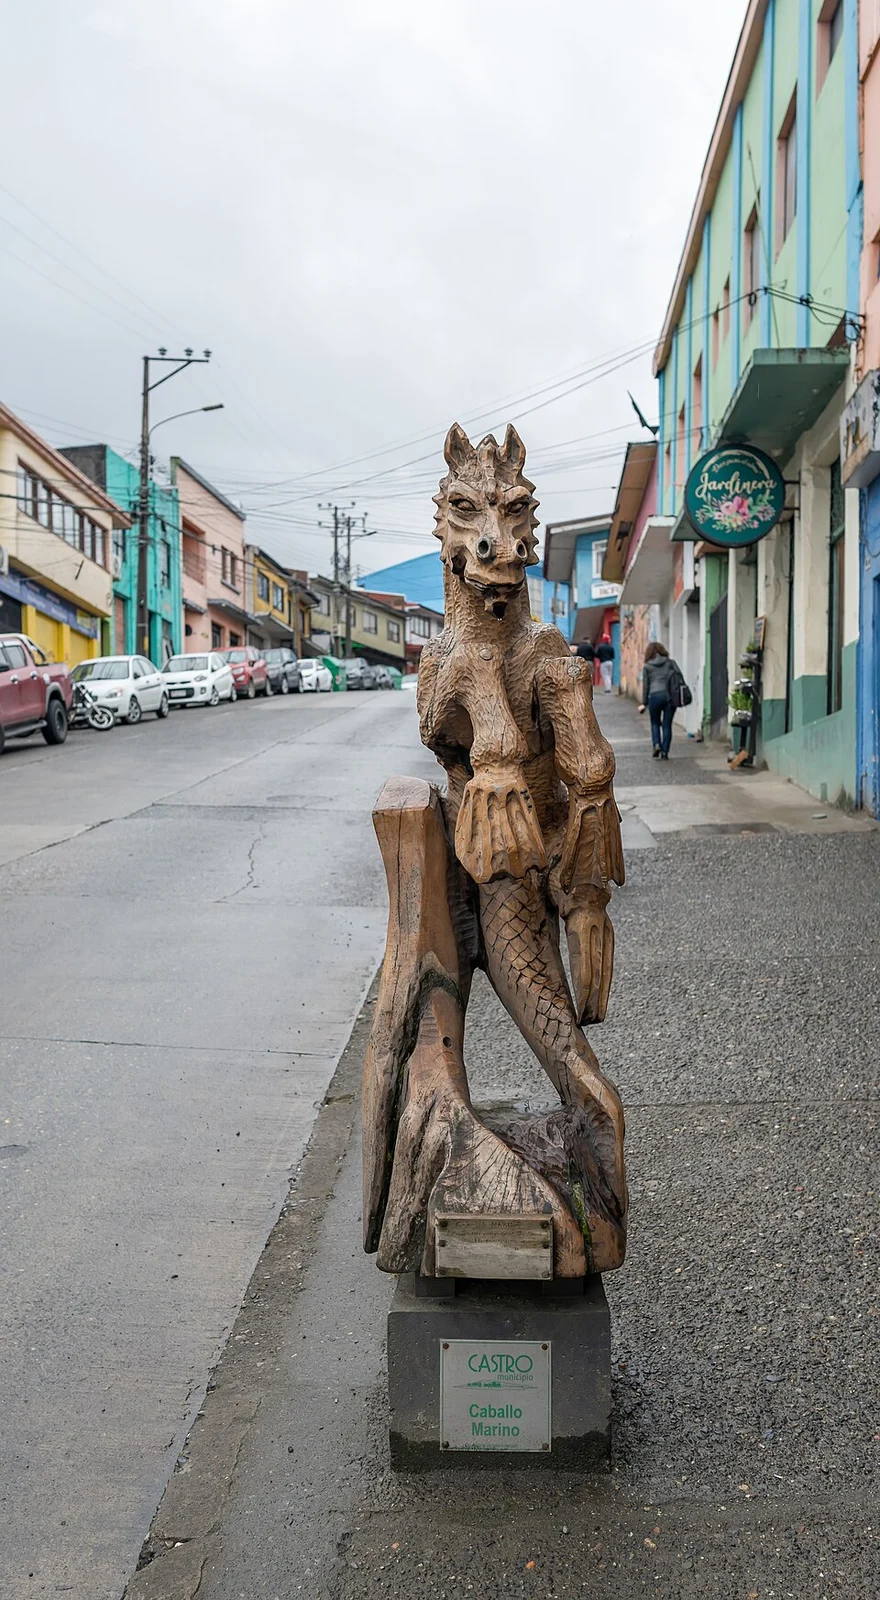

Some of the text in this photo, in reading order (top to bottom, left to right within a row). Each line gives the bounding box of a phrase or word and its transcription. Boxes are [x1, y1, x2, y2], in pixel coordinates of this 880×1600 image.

[695, 471, 777, 498] Jardinera
[468, 1354, 533, 1373] CASTRO
[497, 1373, 534, 1382] municipio
[469, 1404, 522, 1418] Caballo
[471, 1422, 520, 1437] Marino
